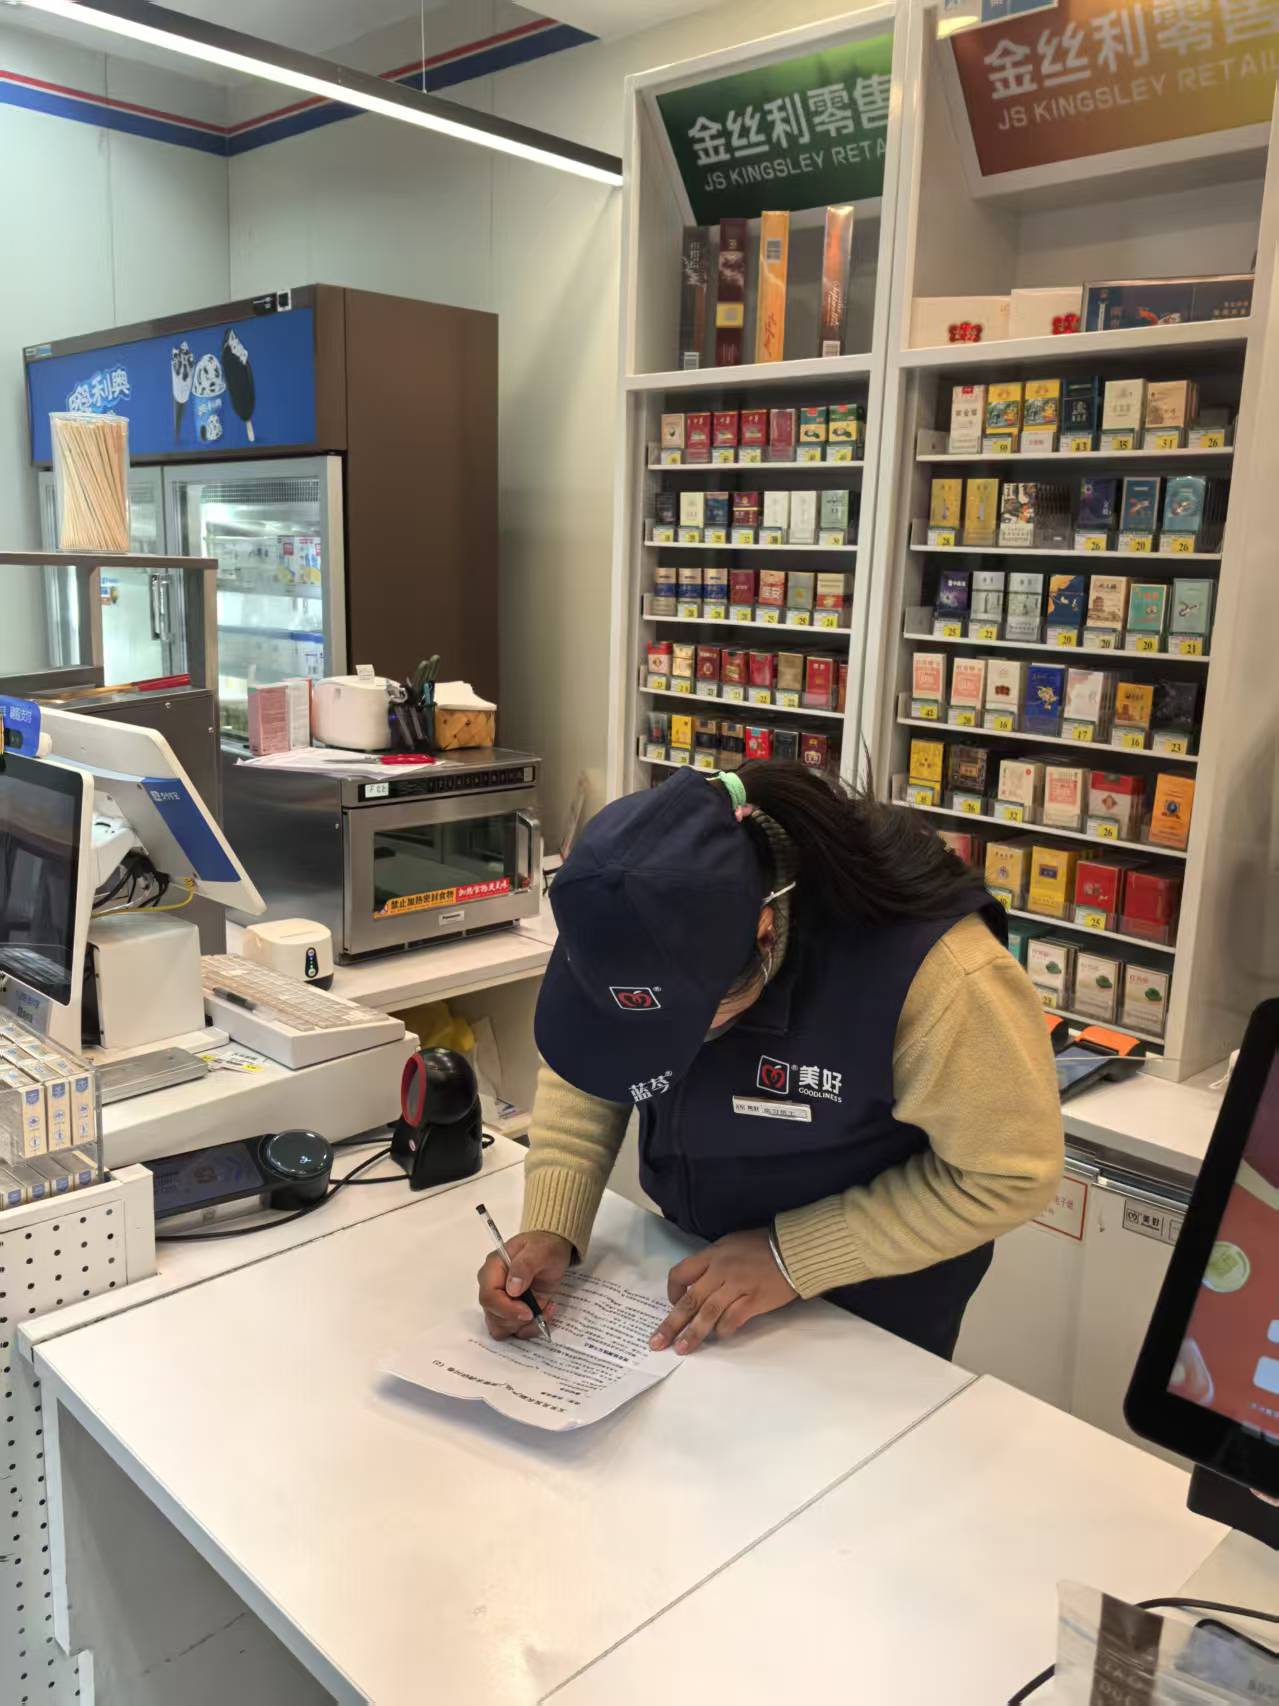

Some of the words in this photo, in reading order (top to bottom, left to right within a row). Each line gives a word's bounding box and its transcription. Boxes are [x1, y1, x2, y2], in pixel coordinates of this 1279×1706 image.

[688, 73, 891, 166] 金丝利零售
[998, 106, 1028, 130] JS
[1033, 74, 1168, 124] KINGSLEY
[704, 171, 728, 191] JS
[729, 150, 825, 185] KINGSLEY
[798, 1065, 842, 1093] 美好
[798, 1086, 843, 1103] GOODLINESS
